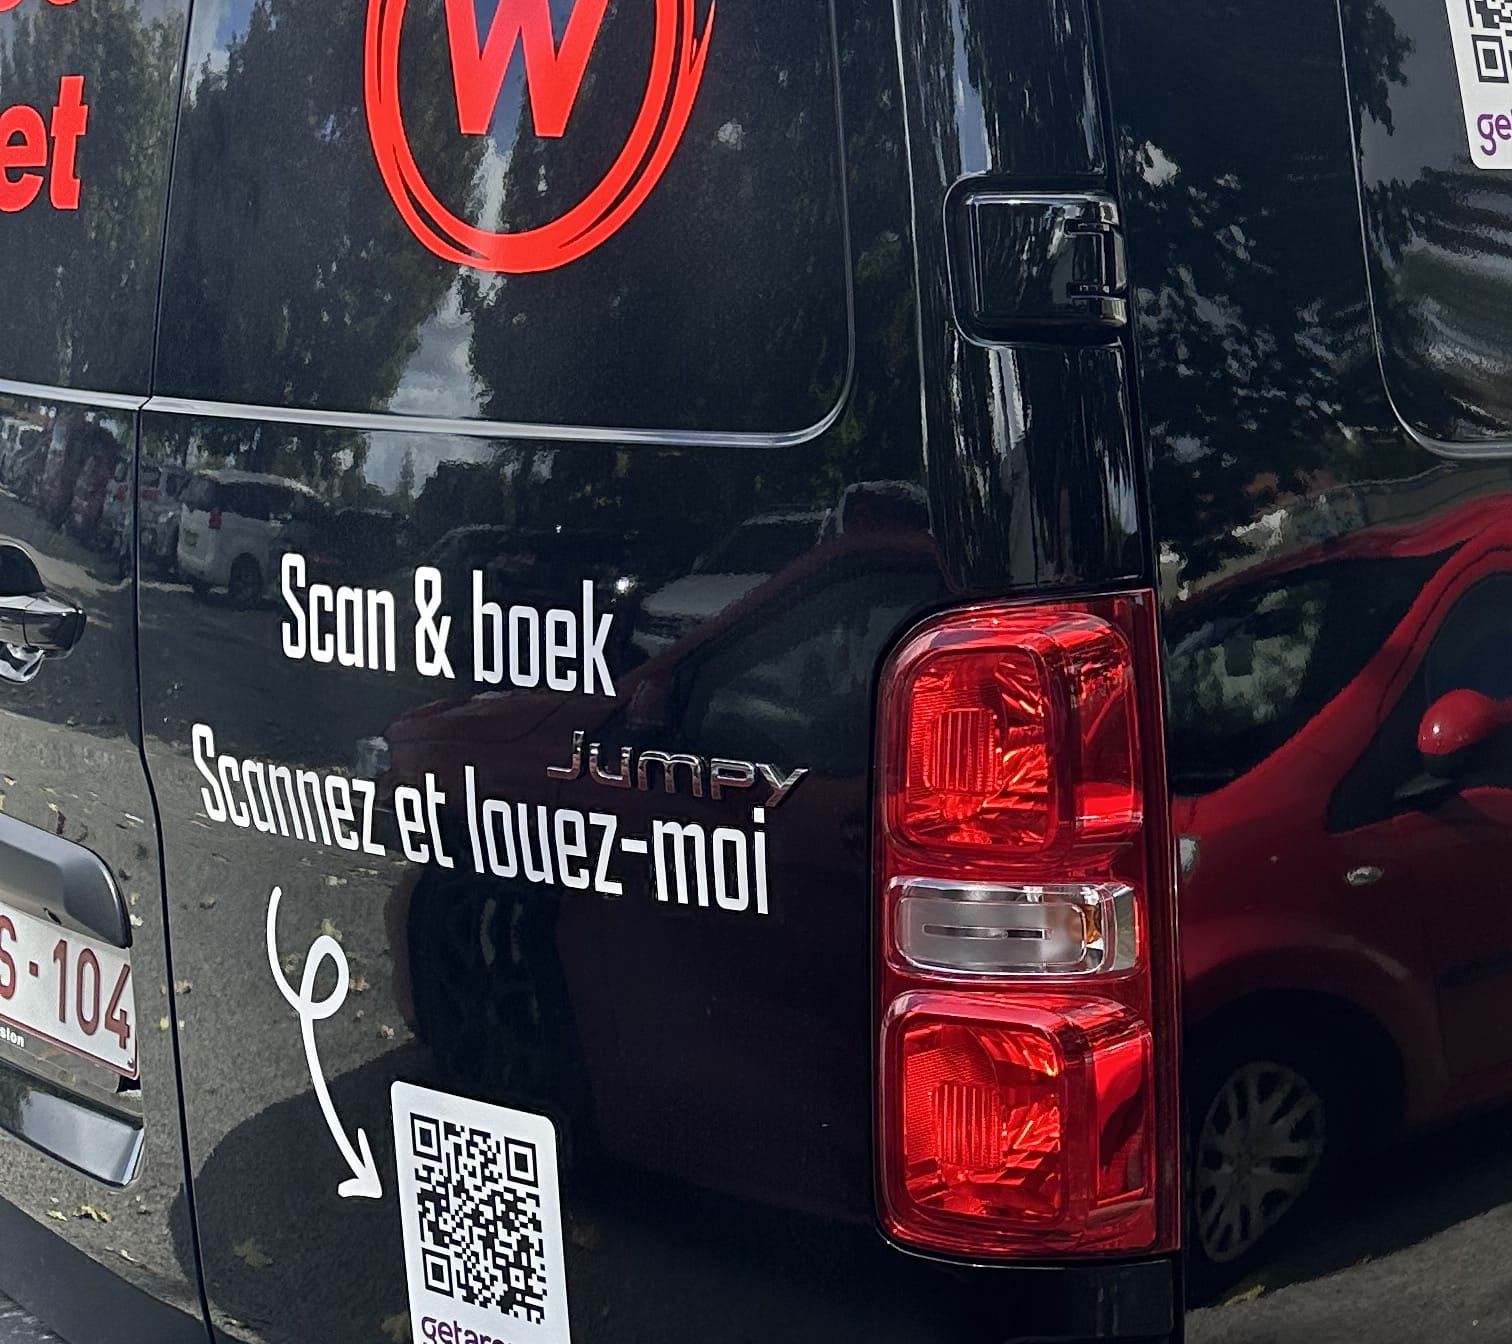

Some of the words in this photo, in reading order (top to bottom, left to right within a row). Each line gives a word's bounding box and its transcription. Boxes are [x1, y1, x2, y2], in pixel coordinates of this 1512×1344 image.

[280, 552, 396, 673] Scan
[414, 565, 456, 679] &
[472, 569, 617, 697] boek
[190, 722, 387, 857] Scannez
[394, 772, 455, 870] et
[464, 765, 770, 916] louez-moi
